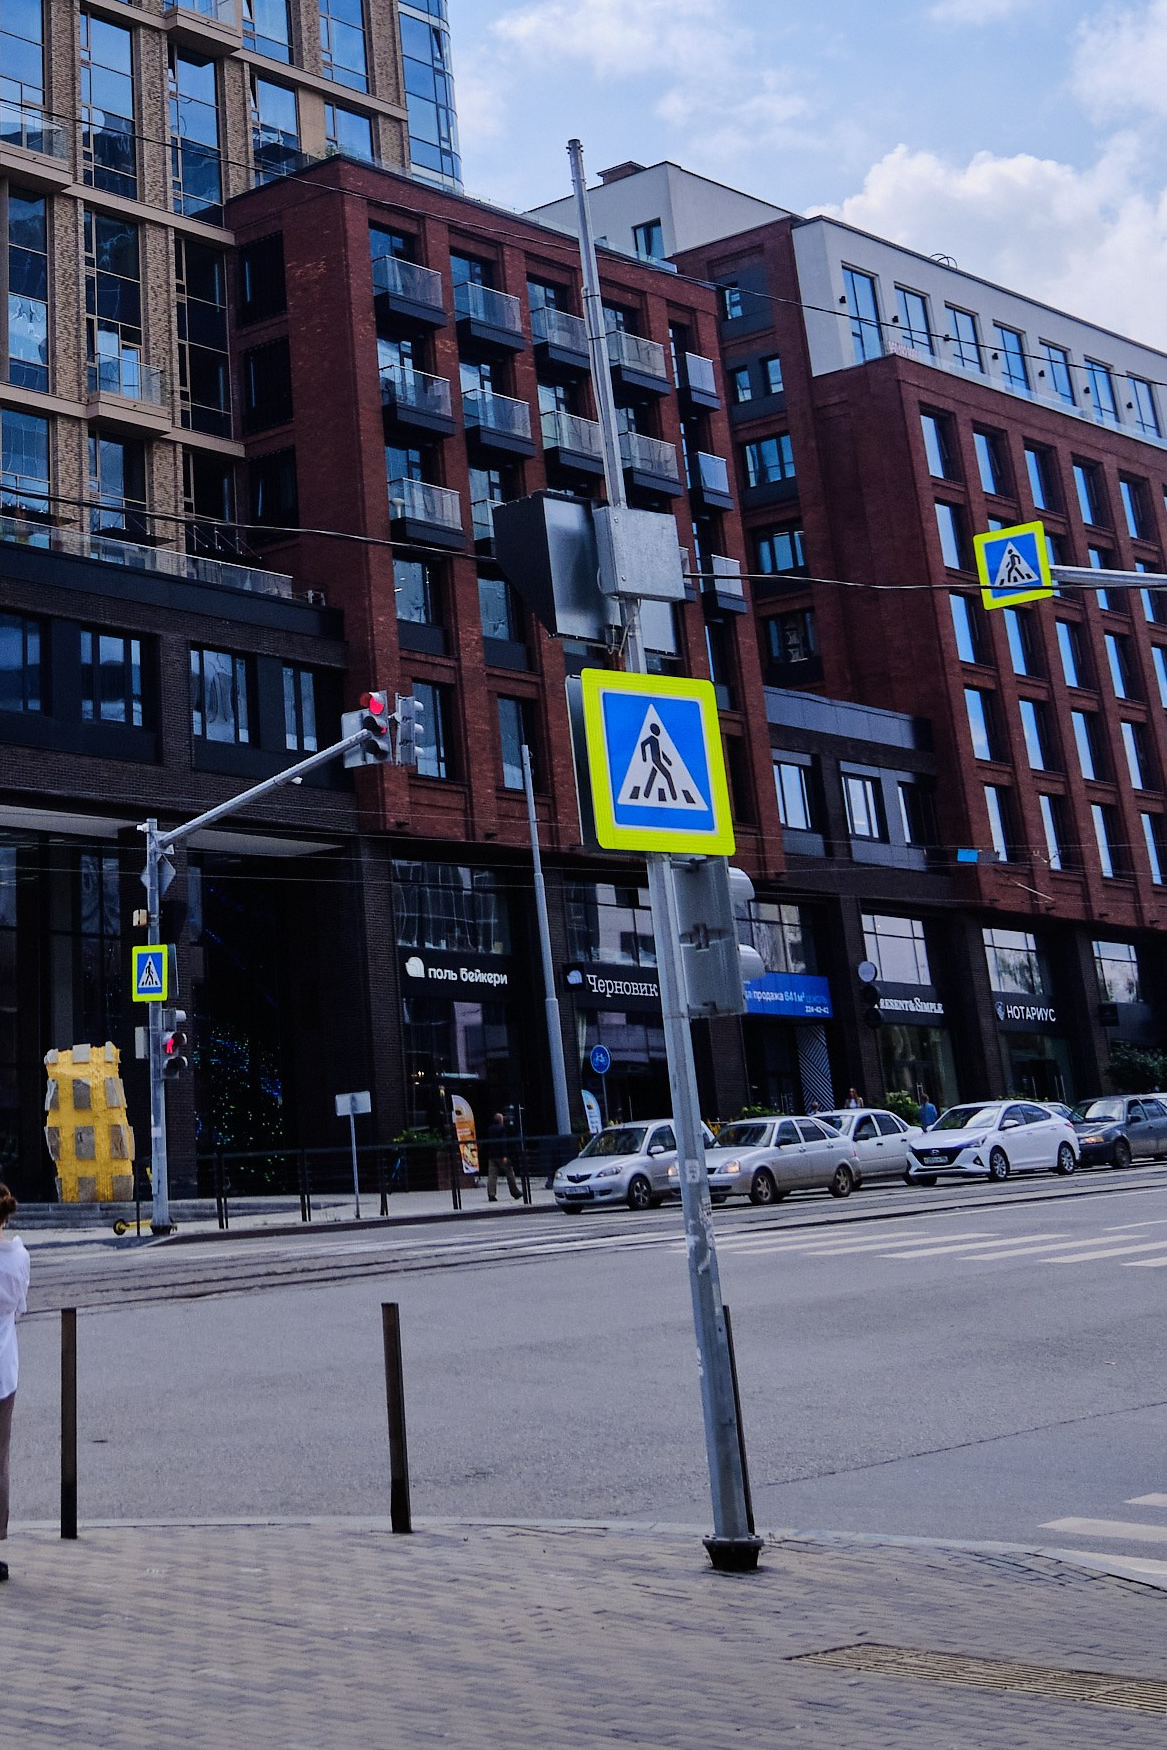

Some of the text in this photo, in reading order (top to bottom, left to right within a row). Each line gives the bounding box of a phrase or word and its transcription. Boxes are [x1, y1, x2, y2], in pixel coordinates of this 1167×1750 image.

[428, 967, 508, 987] поль бейкери
[586, 973, 659, 997] Черновик
[1006, 1005, 1057, 1022] НОТАРИУС
